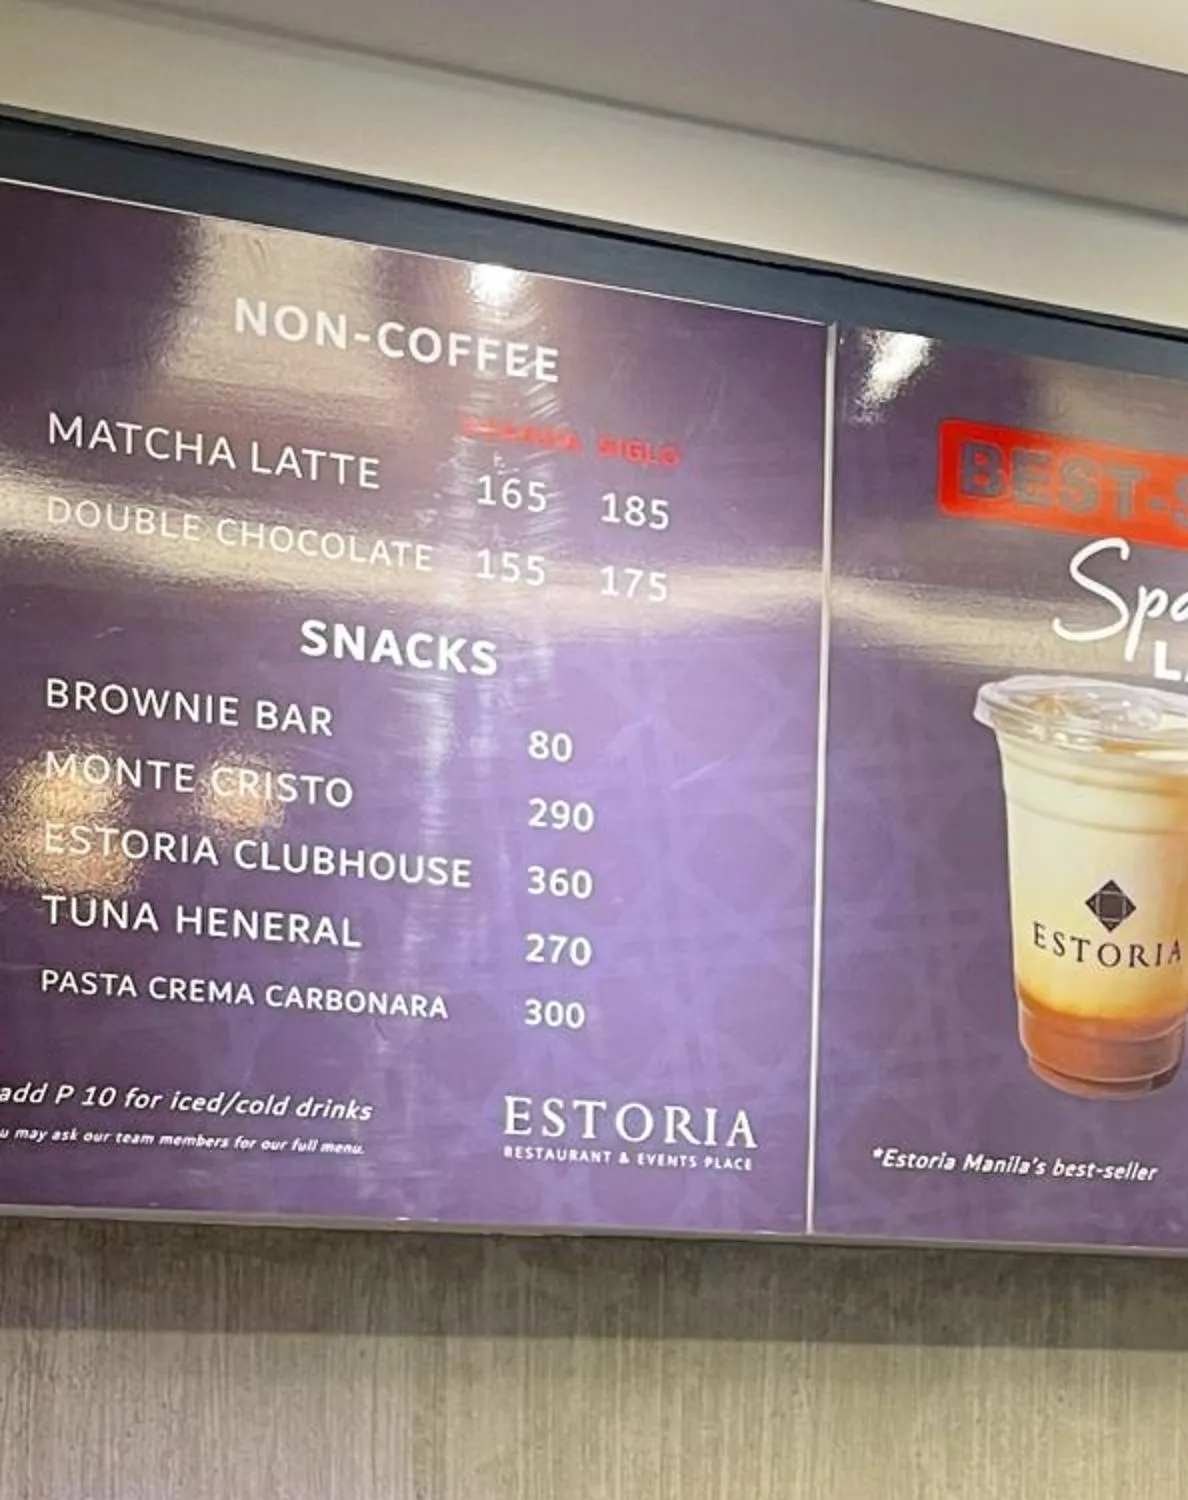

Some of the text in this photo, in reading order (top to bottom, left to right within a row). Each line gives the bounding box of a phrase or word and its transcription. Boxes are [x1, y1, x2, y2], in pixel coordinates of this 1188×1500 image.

[234, 297, 560, 383] NON-COFFEE
[48, 412, 669, 530] MATCHA LATTE 165 185
[598, 435, 682, 468] SIGLO
[47, 496, 667, 602] DOUBLE CHOCOLATE 155 175
[299, 619, 498, 676] SNACKS
[46, 678, 572, 762] BROWNIE BAR 80
[45, 752, 593, 832] MONTE CRISTO 290
[44, 823, 593, 899] ESTORIA CLUBHOUSE 360
[42, 895, 592, 967] TUNA HENERAL 270
[1032, 922, 1183, 969] ESTORIA
[41, 969, 585, 1029] PASTA CREMA CARBONARA 300
[55, 1086, 74, 1104] P
[81, 1087, 116, 1106] 10
[124, 1088, 162, 1109] for
[170, 1091, 289, 1116] iced/cold
[296, 1098, 373, 1121] drinks
[504, 1095, 758, 1148] ESTORIA
[14, 1129, 48, 1142] may
[52, 1129, 77, 1141] ask
[83, 1132, 111, 1142] our
[116, 1133, 154, 1144] team
[160, 1134, 229, 1148] members
[234, 1136, 257, 1149] for
[261, 1140, 287, 1150] our
[292, 1138, 318, 1152] full
[504, 1145, 611, 1163] RESTAURANT
[638, 1153, 697, 1167] EVENTS
[704, 1156, 752, 1171] PLACE
[963, 1153, 1047, 1178] Manila's
[1053, 1158, 1157, 1183] best-seller
